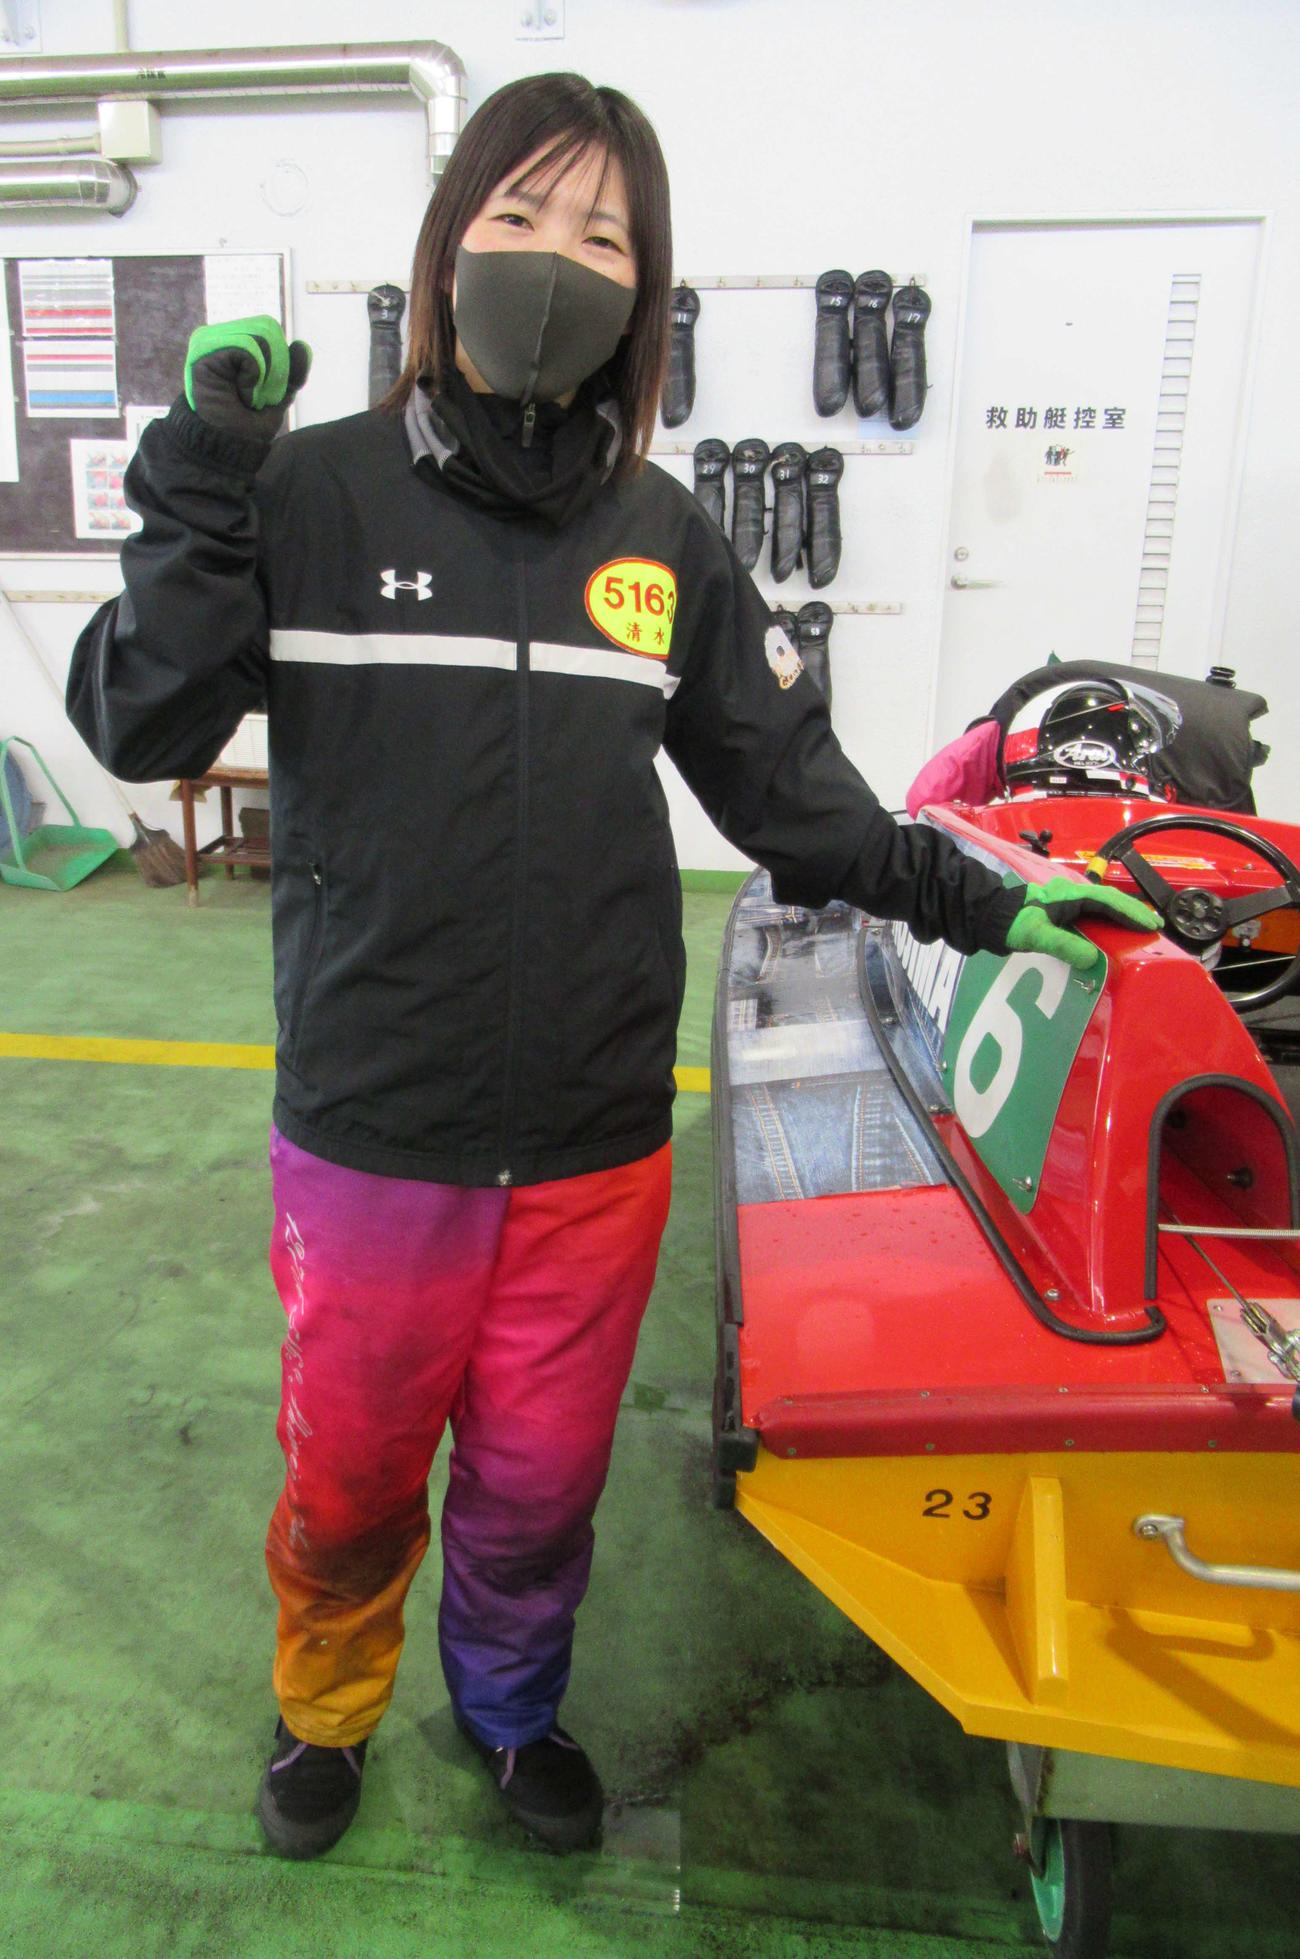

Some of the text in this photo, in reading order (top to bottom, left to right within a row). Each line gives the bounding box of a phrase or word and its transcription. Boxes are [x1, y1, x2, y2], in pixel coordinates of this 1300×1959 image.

[831, 296, 842, 306] 15
[868, 298, 878, 308] 16
[907, 313, 921, 323] 17
[986, 406, 1126, 429] 救助艇控室
[743, 463, 756, 473] 30
[780, 469, 790, 480] 31
[818, 474, 830, 484] 32
[604, 576, 675, 624] 5163
[953, 952, 1072, 1138] 6
[922, 1489, 992, 1521] 23
